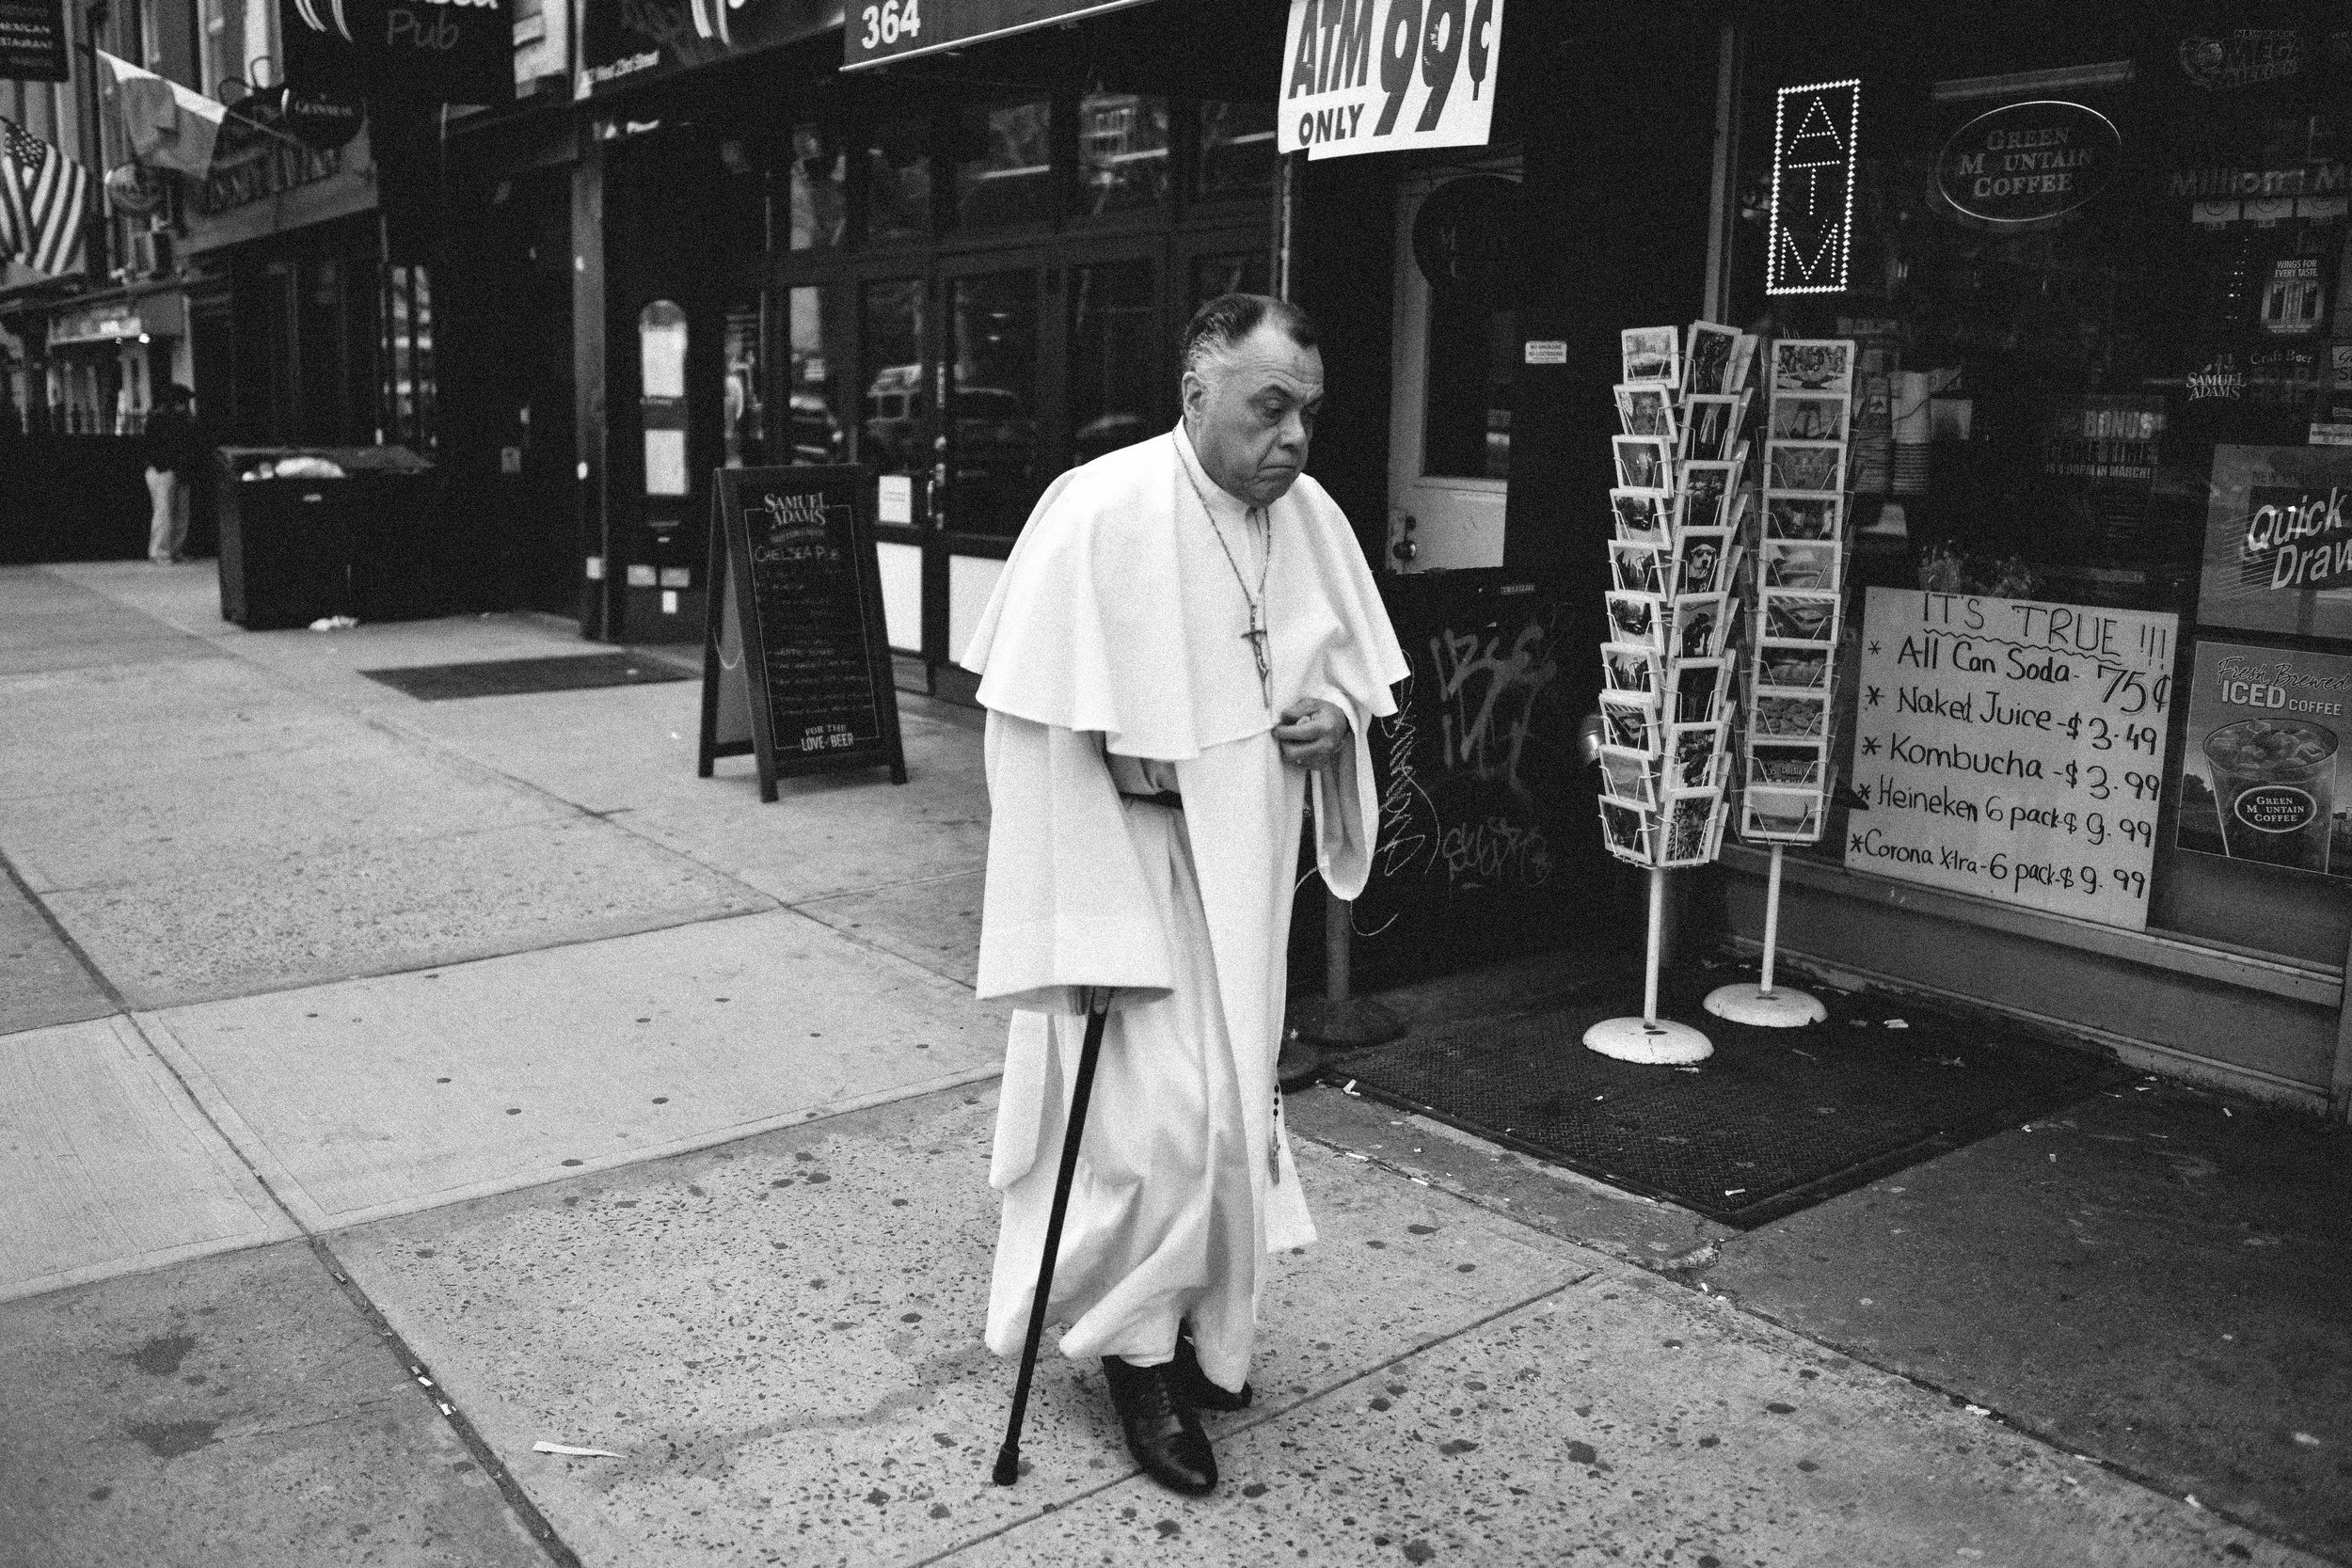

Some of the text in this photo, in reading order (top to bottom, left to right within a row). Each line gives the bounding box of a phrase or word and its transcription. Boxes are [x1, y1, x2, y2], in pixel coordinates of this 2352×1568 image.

[387, 8, 460, 50] Pub
[861, 0, 921, 49] 364
[1288, 0, 1374, 100] ATM
[1298, 103, 1365, 147] ONLY
[1986, 127, 2071, 150] GREEN
[1959, 148, 2094, 176] MUNTAIN
[1780, 96, 1844, 280] ATM
[1974, 173, 2073, 198] COFFEE
[2273, 269, 2296, 278] EVERY
[2276, 259, 2318, 269] WINGS FOR
[2285, 349, 2313, 364] Beer
[2185, 372, 2247, 388] SAMUEL
[2188, 386, 2241, 402] ADAMS
[764, 492, 830, 513] SAMUEL
[771, 508, 826, 529] ADAMS
[2248, 486, 2348, 551] Quick
[1923, 593, 1985, 630] IT'S
[2011, 605, 2122, 657] TRUE
[1898, 635, 1939, 670] All
[1952, 641, 1996, 674] Can
[2217, 657, 2352, 692] Fresh Brewed
[1897, 686, 1974, 723] Naked
[2221, 679, 2343, 717] ICED COFFEE
[801, 736, 825, 752] LOVE
[830, 733, 854, 749] BEER
[805, 725, 824, 736] FOR
[1890, 732, 2043, 780] Kombucha
[1878, 774, 1979, 822] Heineken
[1986, 795, 2004, 822] 6
[2246, 804, 2305, 815] MUNTAIN
[2255, 796, 2294, 806] GREEN
[2254, 813, 2298, 823] COFFEE
[1865, 828, 1934, 865] Corona
